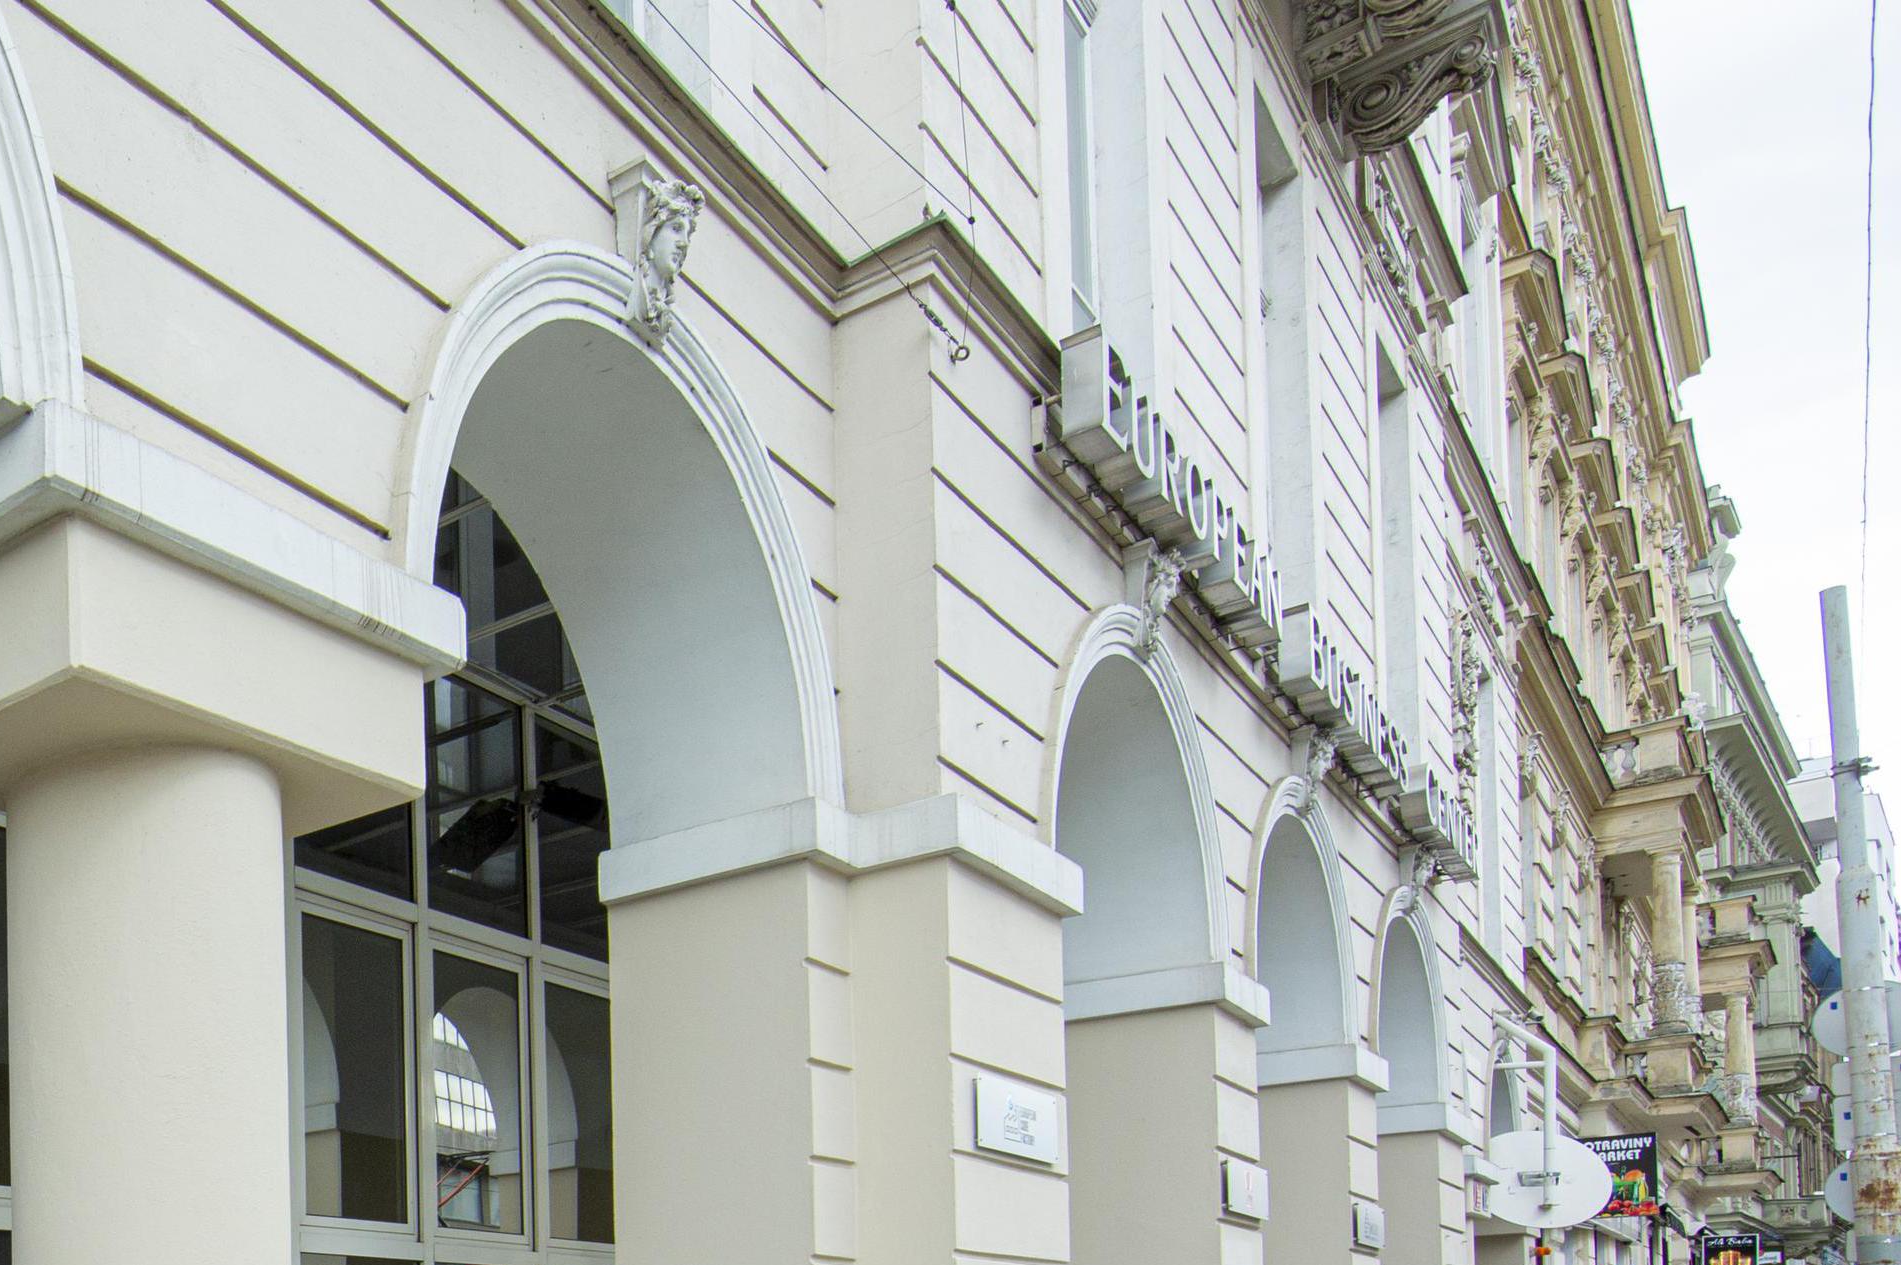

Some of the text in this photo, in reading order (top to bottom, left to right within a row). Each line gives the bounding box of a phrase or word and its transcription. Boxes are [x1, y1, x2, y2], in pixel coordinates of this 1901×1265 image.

[1101, 323, 1283, 642] EUROPEAN
[1309, 602, 1409, 793] BUSINESS
[1584, 1137, 1653, 1152] OTRAVINY
[1598, 1149, 1642, 1162] ARKET
